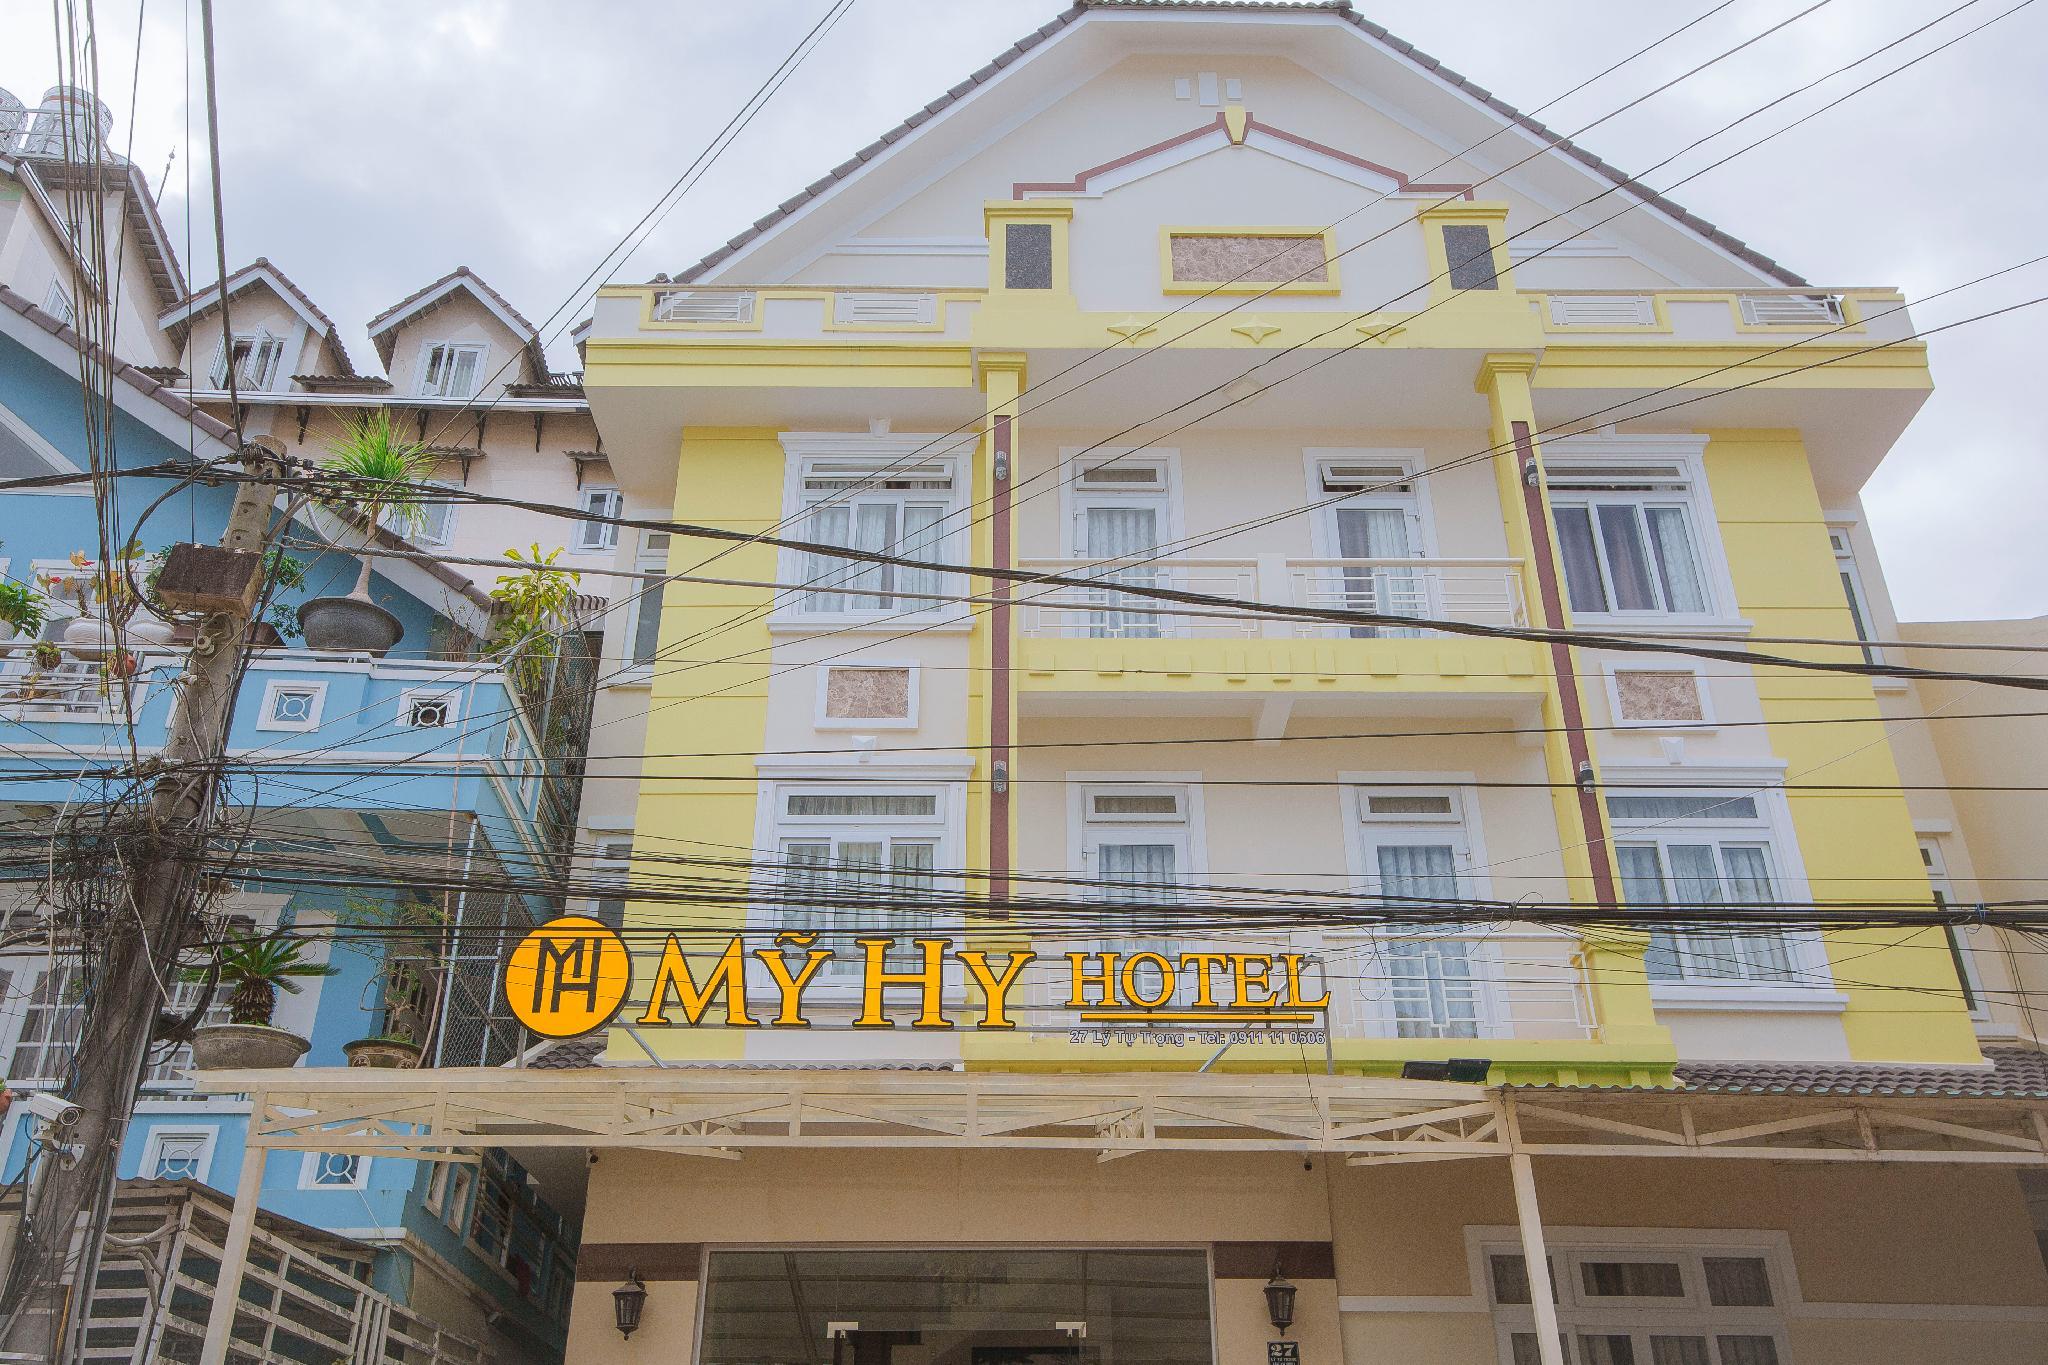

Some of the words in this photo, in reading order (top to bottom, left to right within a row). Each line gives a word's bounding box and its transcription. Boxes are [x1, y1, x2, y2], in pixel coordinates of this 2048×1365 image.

[636, 931, 836, 1028] MỸ
[852, 938, 1037, 1030] HY
[1064, 952, 1331, 1008] HOTEL
[1070, 1030, 1088, 1043] 27
[1092, 1030, 1111, 1046] Lý
[1114, 1030, 1137, 1047] Tự
[1140, 1031, 1185, 1047] Trọng
[1198, 1031, 1225, 1044] Tel:
[1229, 1031, 1263, 1044] 0911
[1267, 1031, 1284, 1044] 11
[1270, 1344, 1295, 1356] 27
